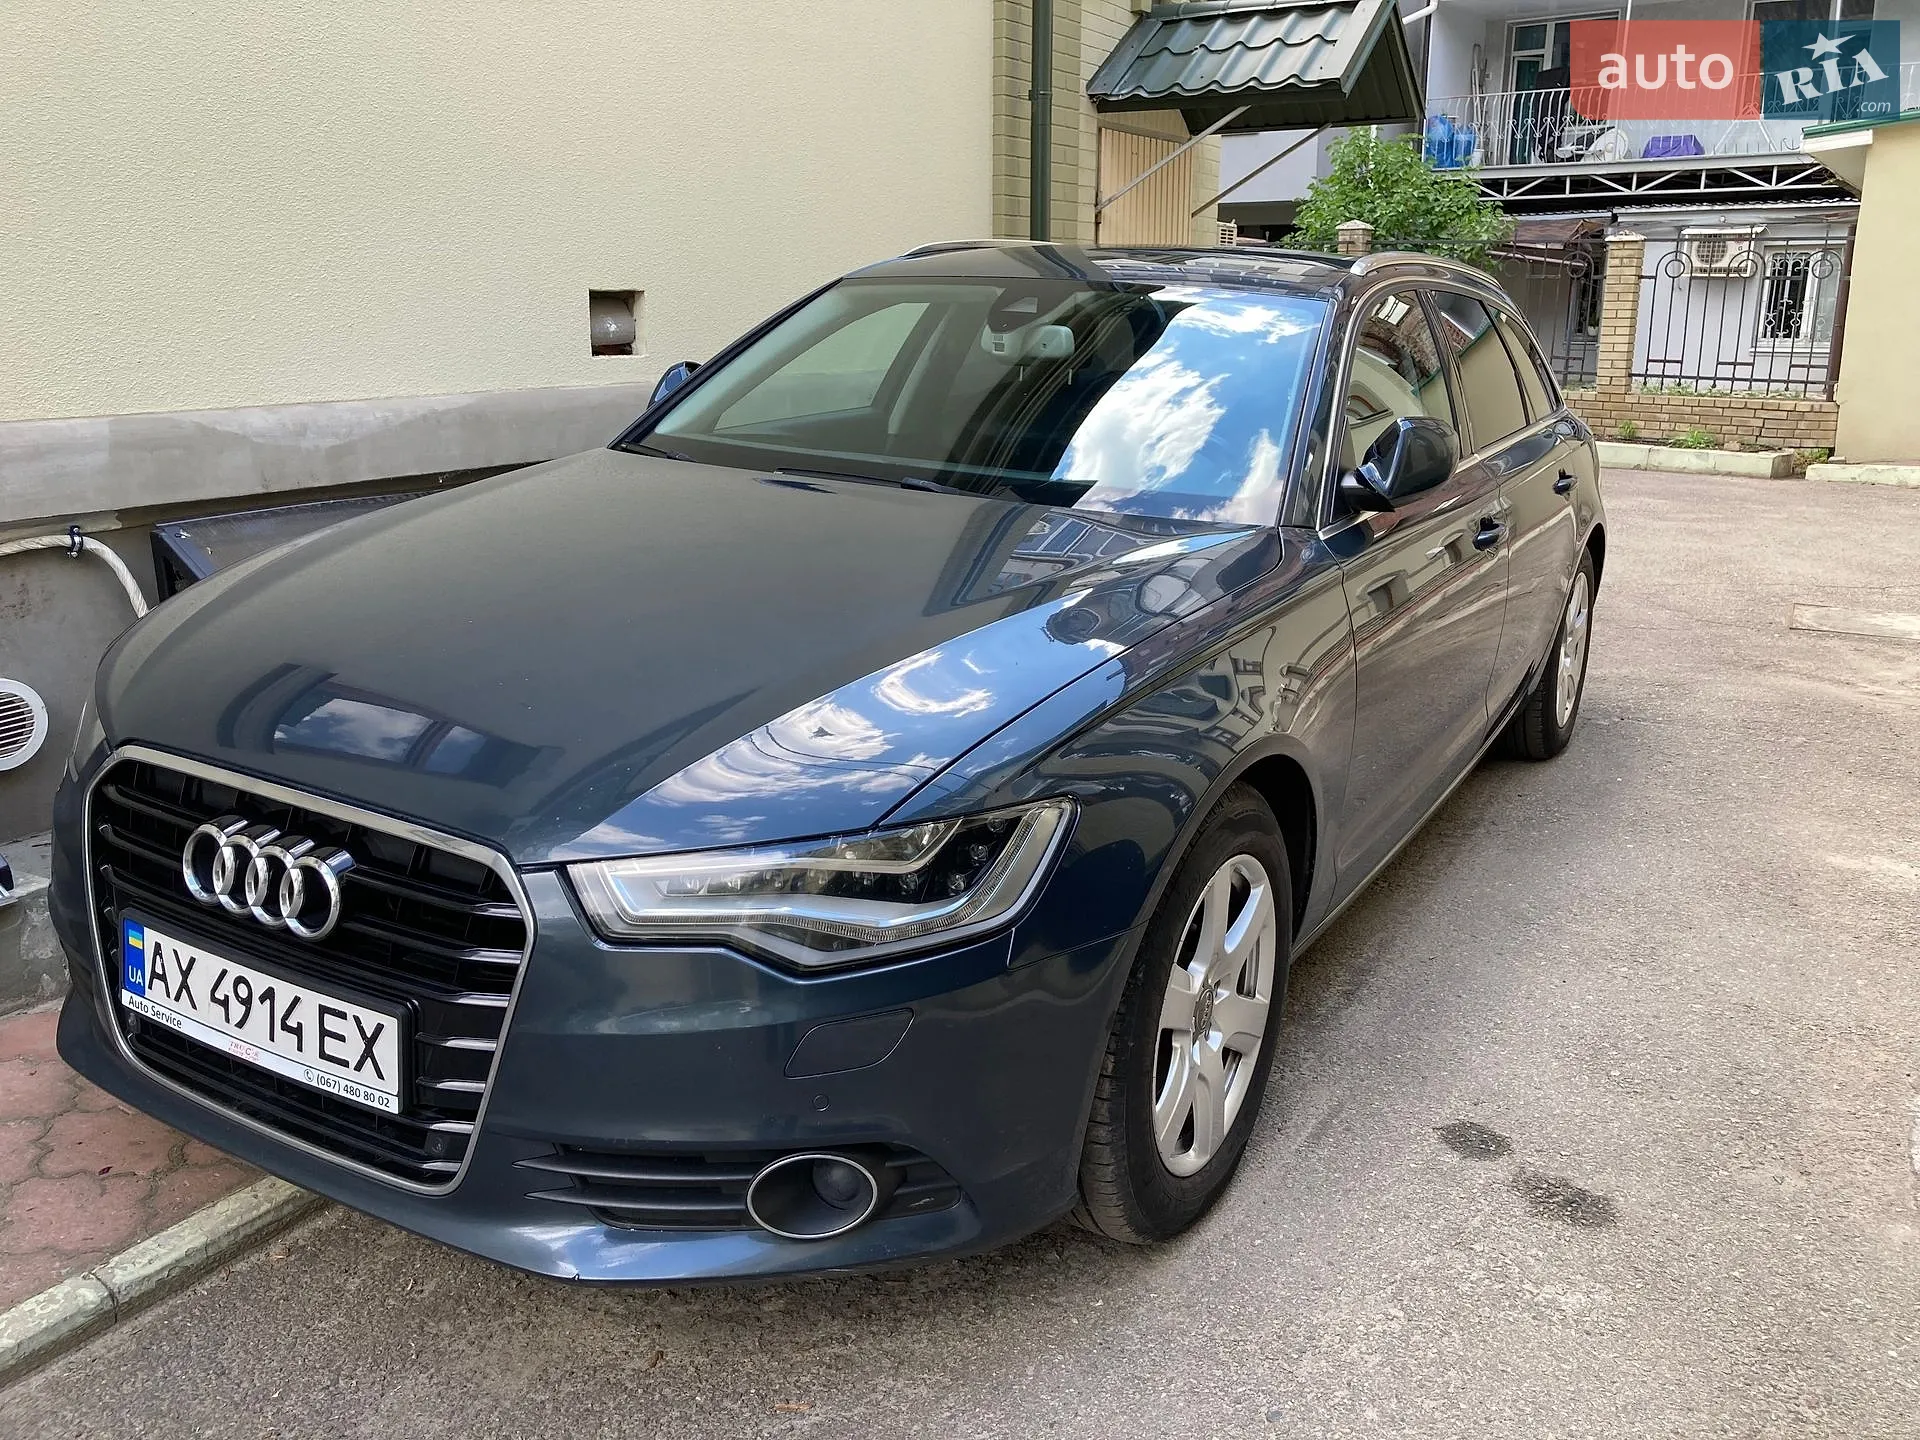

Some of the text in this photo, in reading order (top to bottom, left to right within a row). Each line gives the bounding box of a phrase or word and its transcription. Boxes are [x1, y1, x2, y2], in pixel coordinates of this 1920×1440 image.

[128, 965, 144, 987] UA
[128, 994, 182, 1029] Auto Service
[147, 940, 385, 1081] AX 4914 EX
[316, 1075, 390, 1108] (067) 480 80 02
